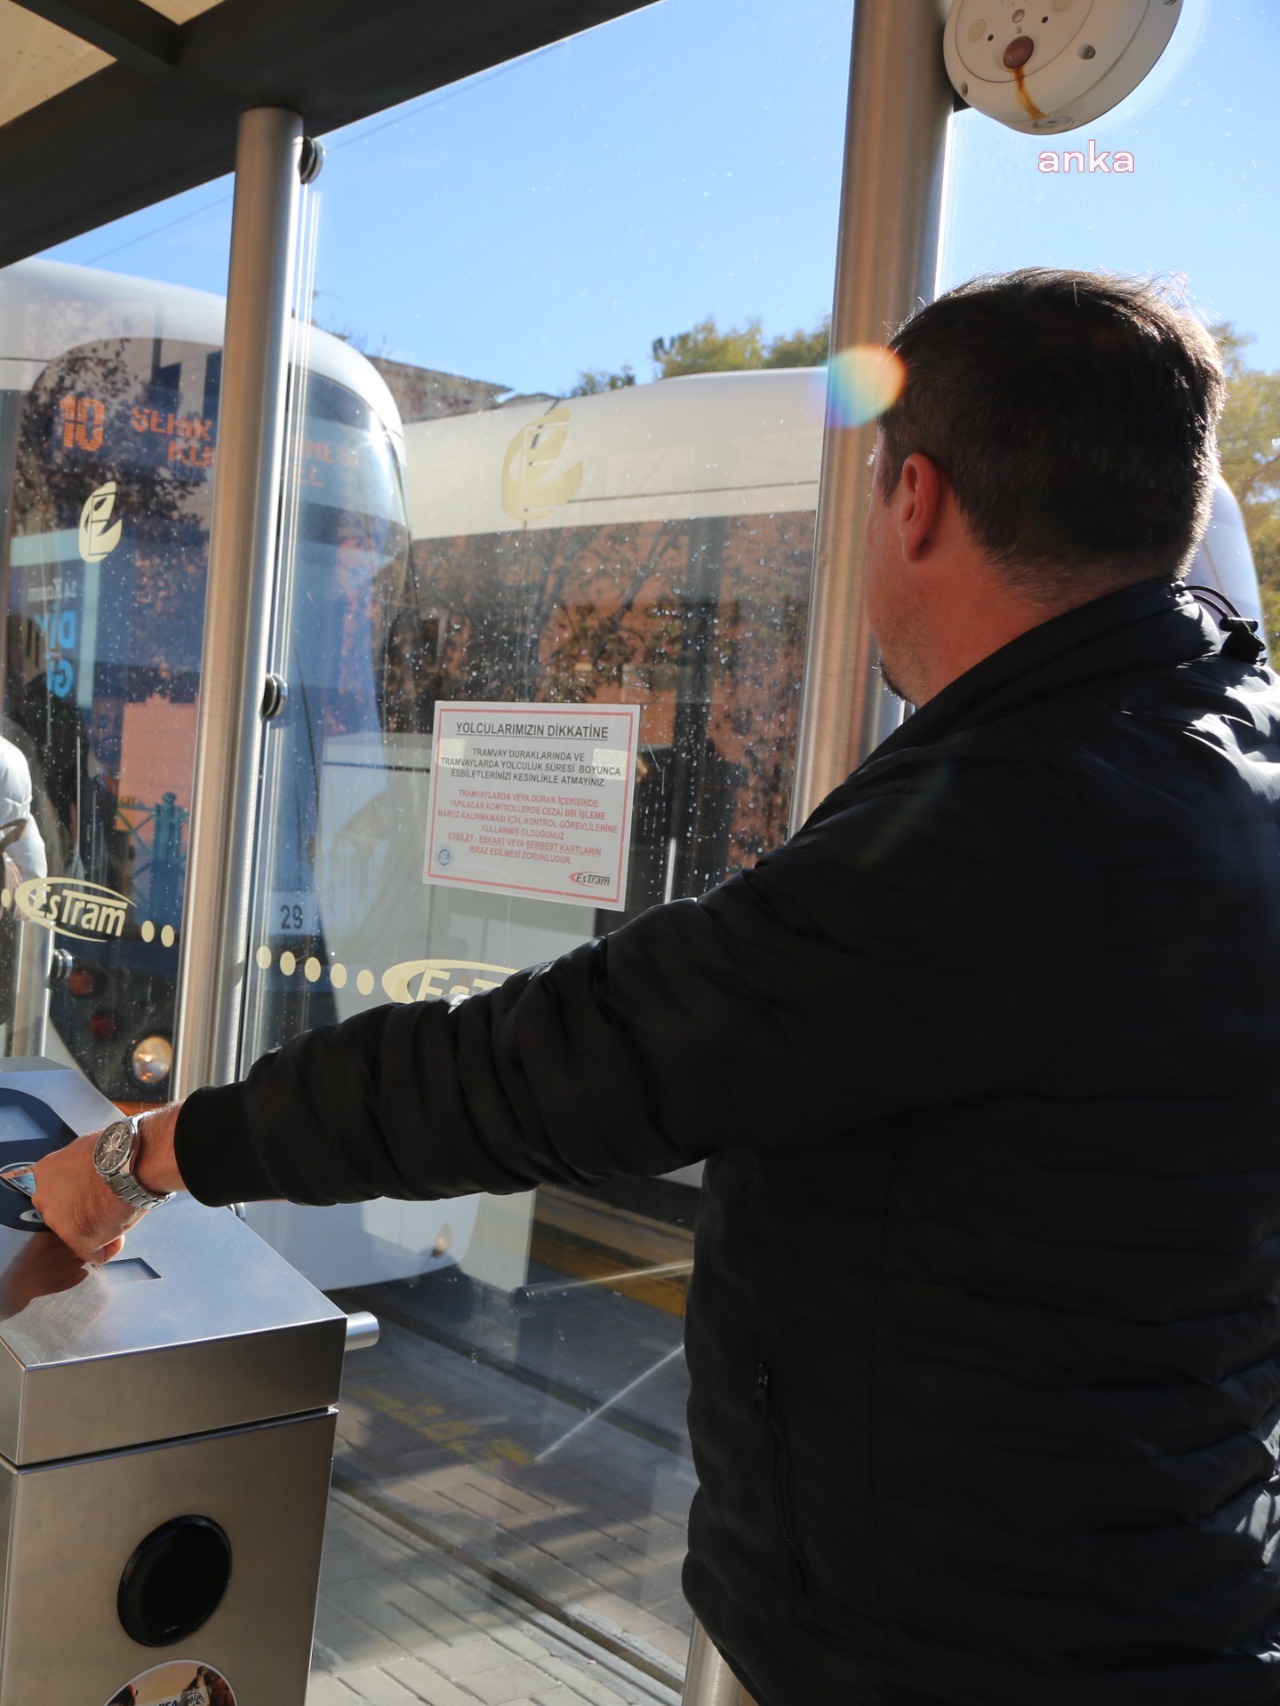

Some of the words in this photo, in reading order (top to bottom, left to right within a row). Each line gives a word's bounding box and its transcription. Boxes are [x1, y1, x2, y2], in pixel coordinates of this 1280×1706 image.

[60, 395, 105, 452] 10
[456, 722, 544, 736] YOLCULARIMIZIN
[547, 723, 609, 738] DİKKATİNE
[473, 748, 507, 758] TRAMVAY
[509, 750, 572, 761] DURAKLARINDA
[574, 753, 585, 762] VE
[441, 757, 499, 769] TRAMVAYLARDA
[501, 761, 543, 771] YOLCULUK
[545, 762, 575, 773] SÜRESİ
[579, 765, 621, 776] BOYUNCA
[451, 768, 511, 780] ESBİLETLERİNİZİ
[513, 772, 559, 784] KESİNLİKLE
[561, 776, 606, 787] ATMAYINIZ.
[459, 789, 510, 800] TRAMVAYLARDA
[512, 792, 530, 802] VEYA
[531, 794, 556, 804] DURAK
[558, 795, 598, 808] İÇERİSİNDE
[449, 800, 486, 809] YAPILACAK
[486, 803, 540, 815] KONTROLLERDE
[564, 808, 577, 818] BİR
[579, 808, 606, 820] İŞLEME
[438, 809, 460, 819] MARUZ
[461, 811, 506, 823] KALINMAMASI
[524, 816, 557, 828] KONTROL
[559, 819, 619, 833] GÖREVLİLERİNE
[481, 824, 519, 837] KULLANMIŞ
[521, 828, 565, 840] OLDUĞUNUZ
[448, 831, 474, 842] ESBİLET
[479, 835, 505, 846] ESKART
[507, 838, 524, 848] VEYA
[526, 840, 559, 851] SERBEST
[560, 844, 601, 856] KARTLARIN
[469, 844, 488, 855] İBRAZ
[489, 847, 521, 858] EDİLMESİ
[522, 851, 572, 864] ZORUNLUDUR.
[576, 873, 610, 886] EsTram
[32, 884, 128, 937] EsTram
[280, 904, 303, 930] 29
